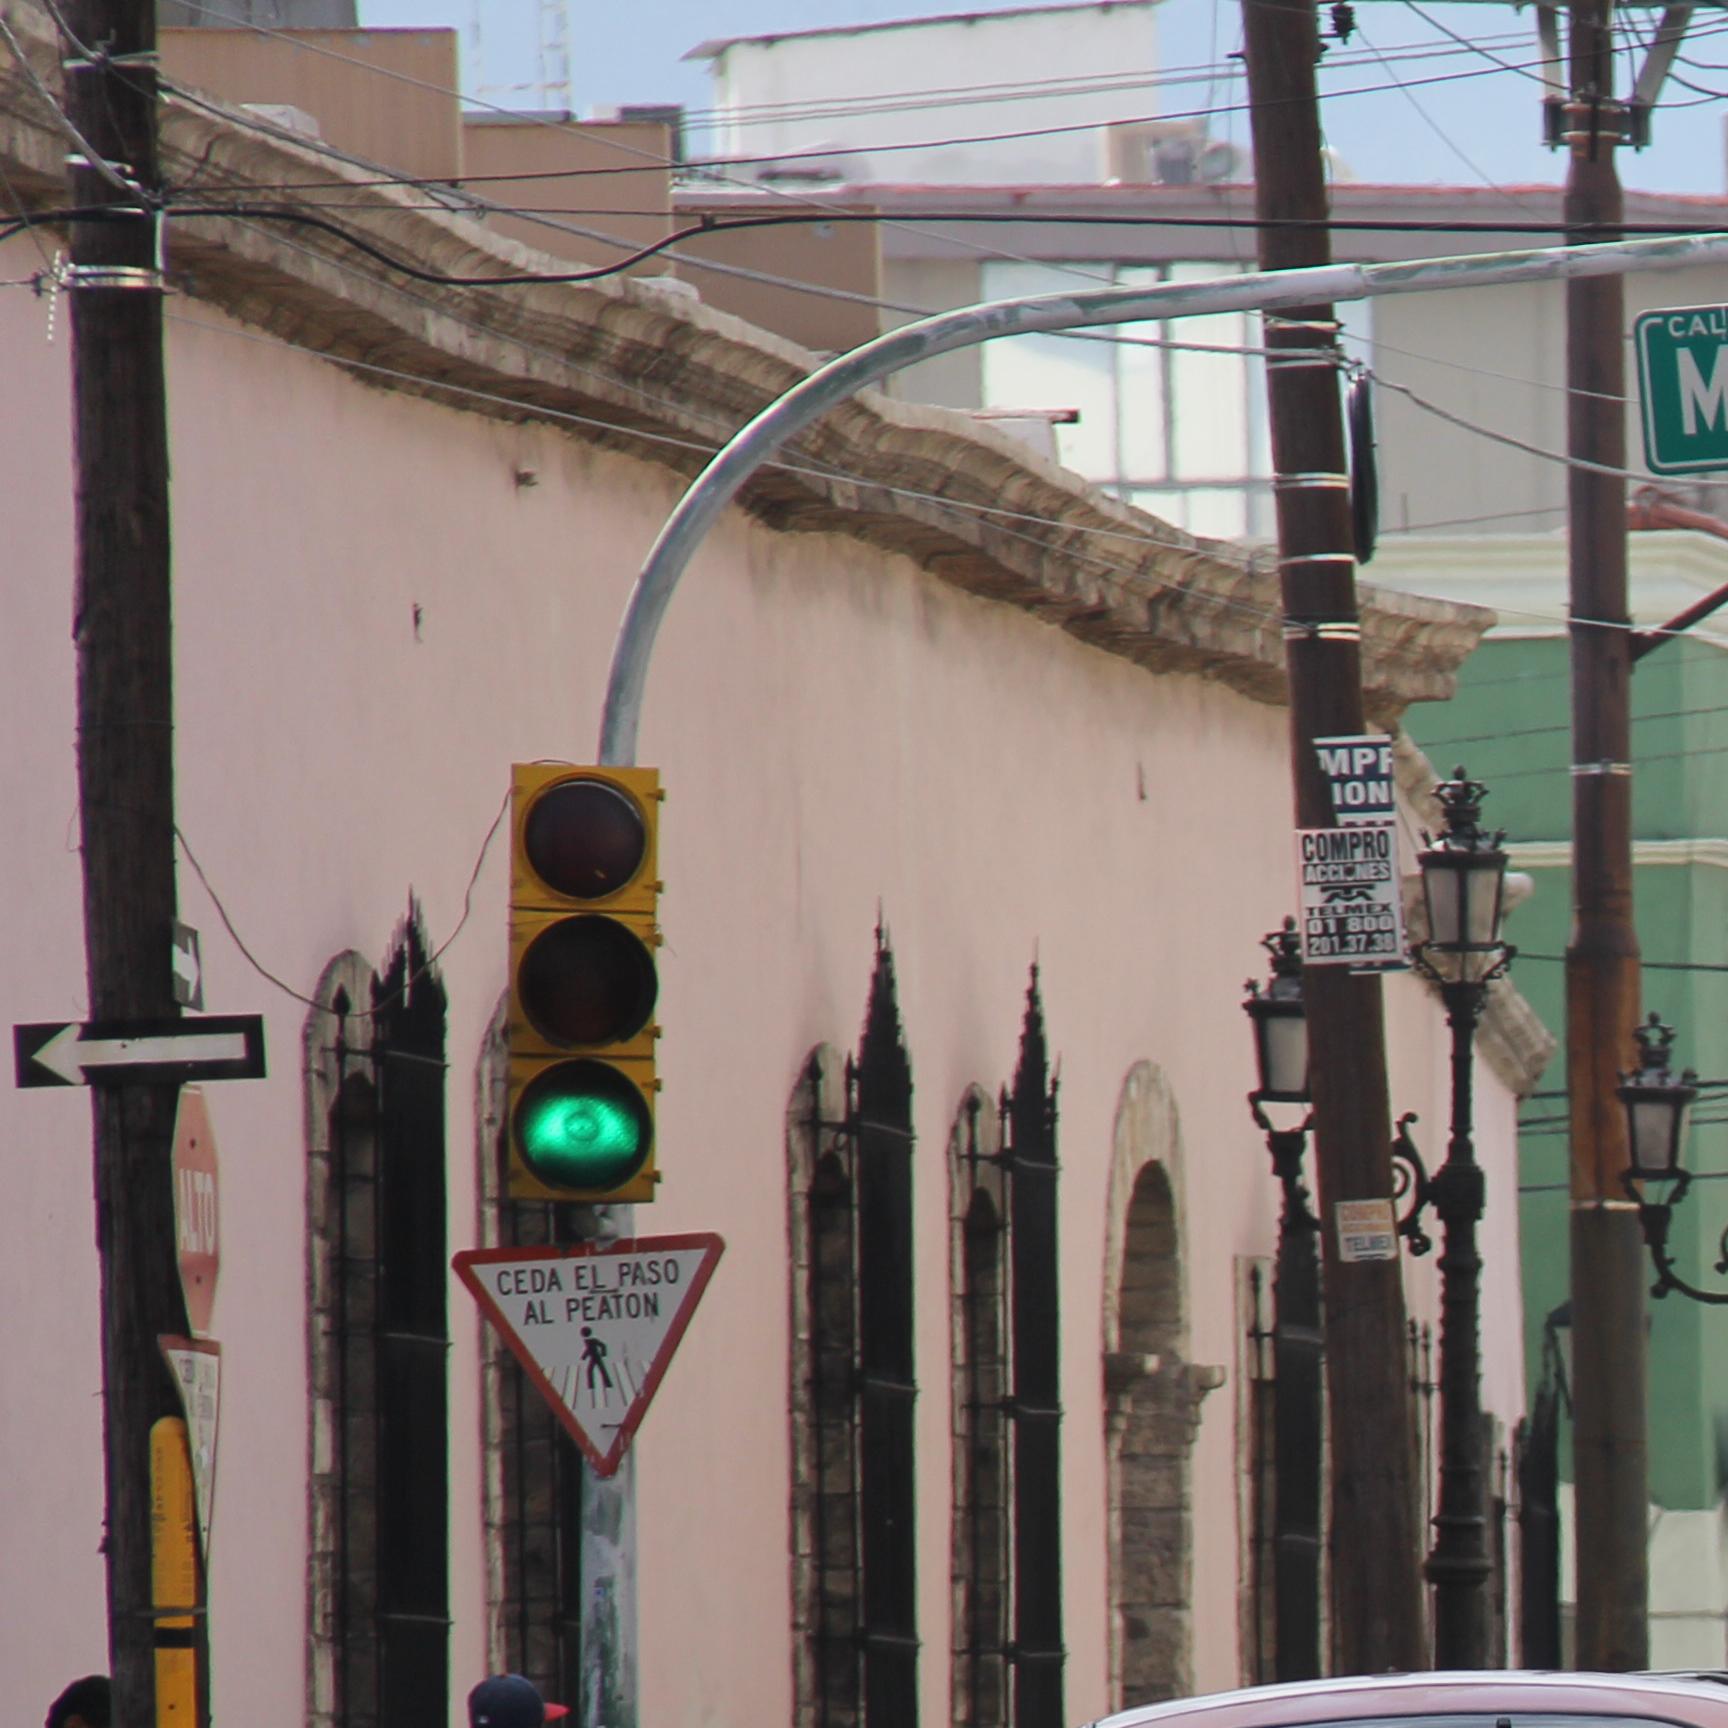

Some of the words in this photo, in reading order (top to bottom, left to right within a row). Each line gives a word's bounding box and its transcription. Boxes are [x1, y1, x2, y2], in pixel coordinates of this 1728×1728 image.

[1301, 830, 1390, 862] COMPRO
[1304, 862, 1391, 884] ACCIONES
[1306, 902, 1392, 917] TELMEX
[1308, 917, 1337, 935] 01
[1346, 915, 1393, 932] 800
[496, 1268, 563, 1297] CEDA
[574, 1264, 607, 1292] EL
[618, 1257, 680, 1288] PASO
[523, 1300, 554, 1326] AL
[566, 1292, 660, 1323] PEATON
